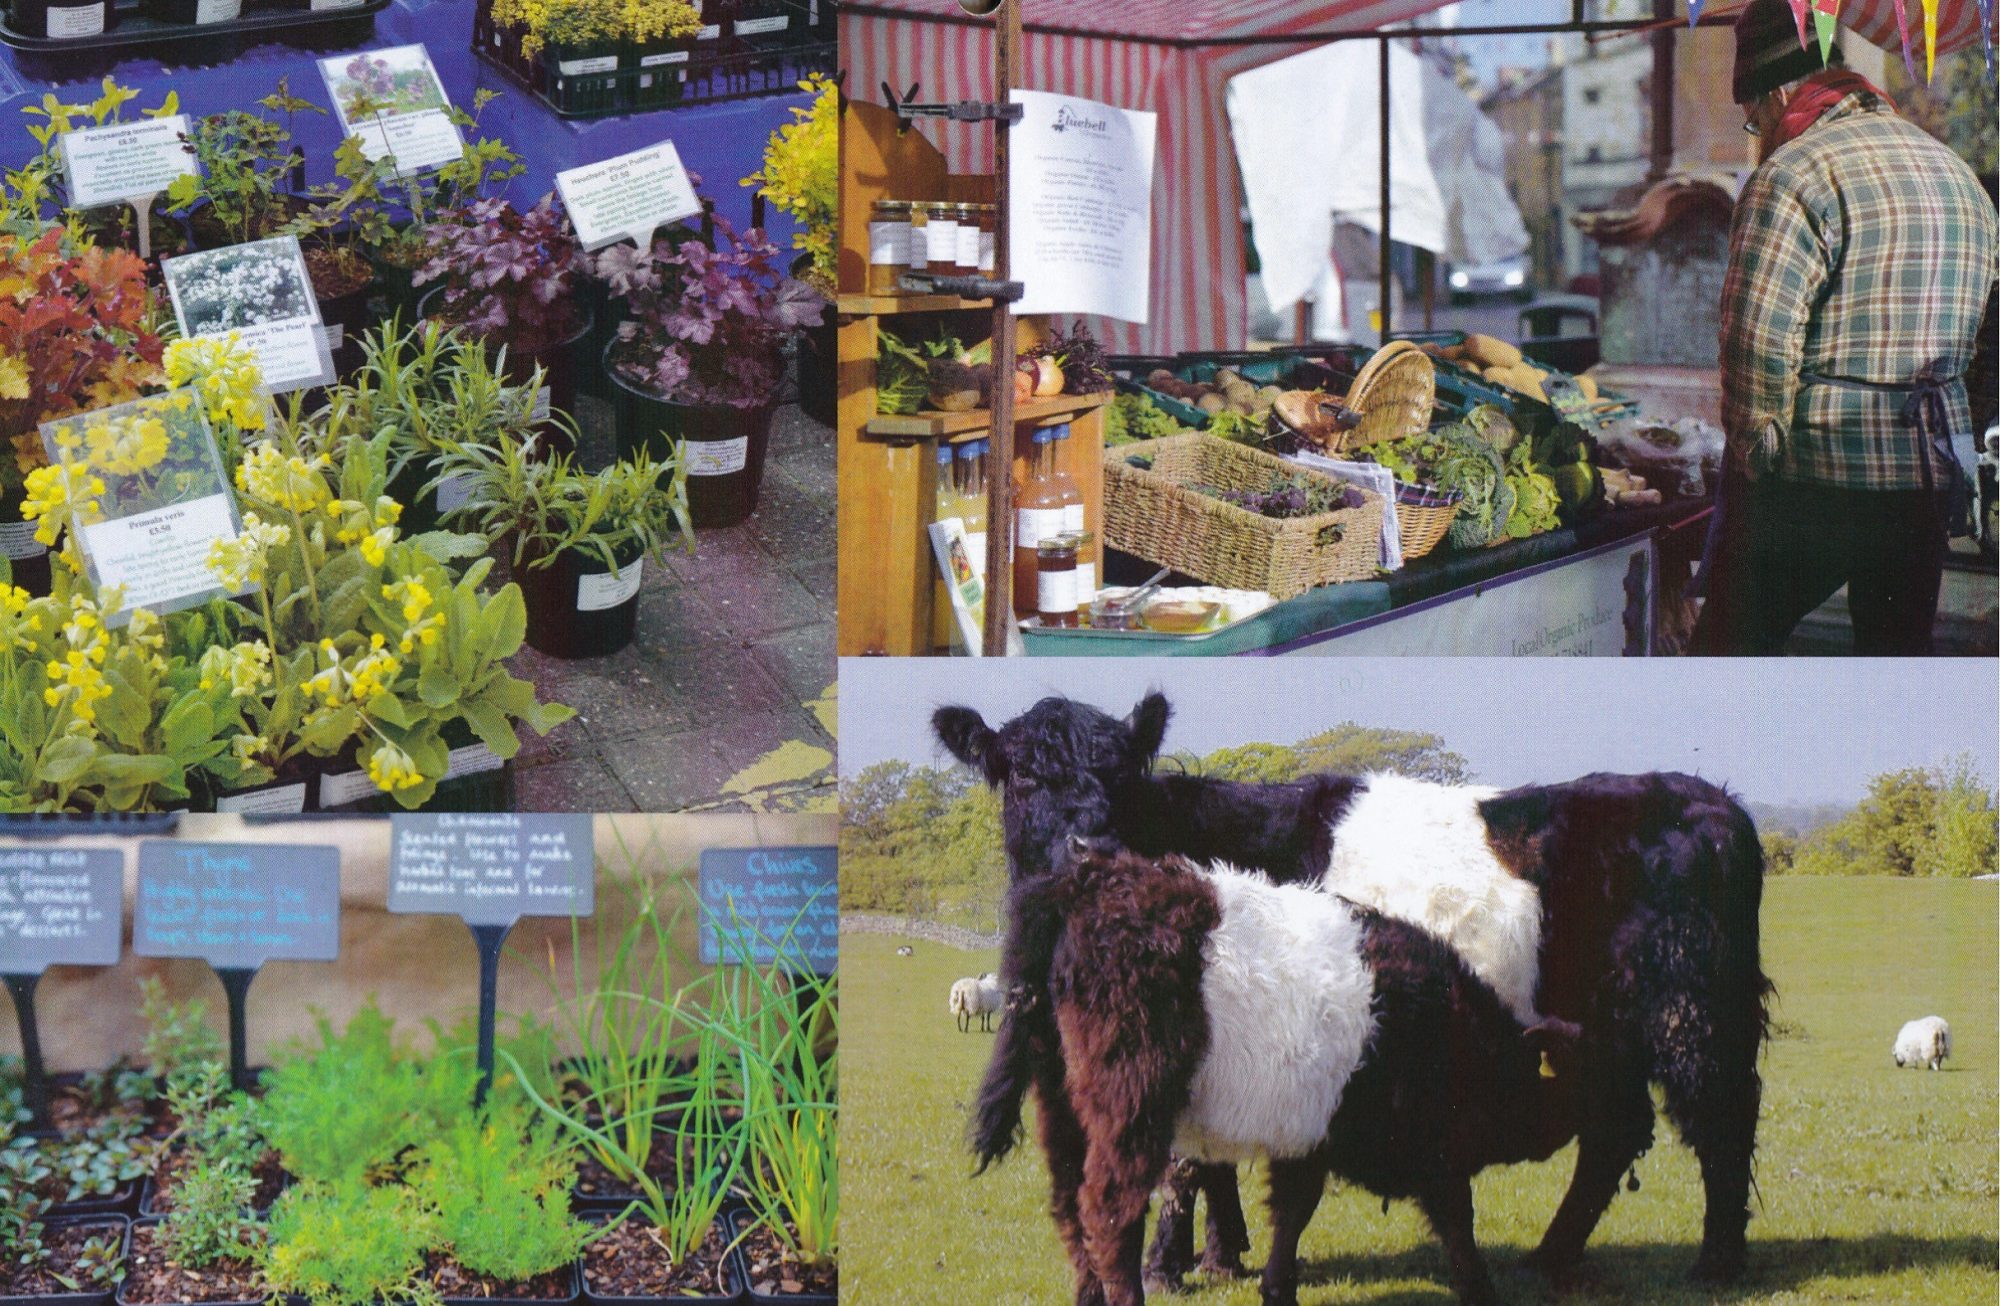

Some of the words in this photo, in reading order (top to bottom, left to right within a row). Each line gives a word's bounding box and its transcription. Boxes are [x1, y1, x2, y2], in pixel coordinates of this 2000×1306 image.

[84, 129, 131, 142] Pachysandra
[570, 170, 606, 183] Heuchera
[128, 515, 163, 529] Primula
[163, 510, 185, 519] veris
[1511, 630, 1538, 656] Local
[400, 830, 456, 845] Scented
[465, 831, 518, 847] flowers
[529, 832, 566, 844] and
[528, 846, 572, 861] make
[174, 848, 251, 887] Thyme
[485, 866, 513, 877] and
[746, 852, 818, 875] Chives
[706, 878, 746, 899] Use
